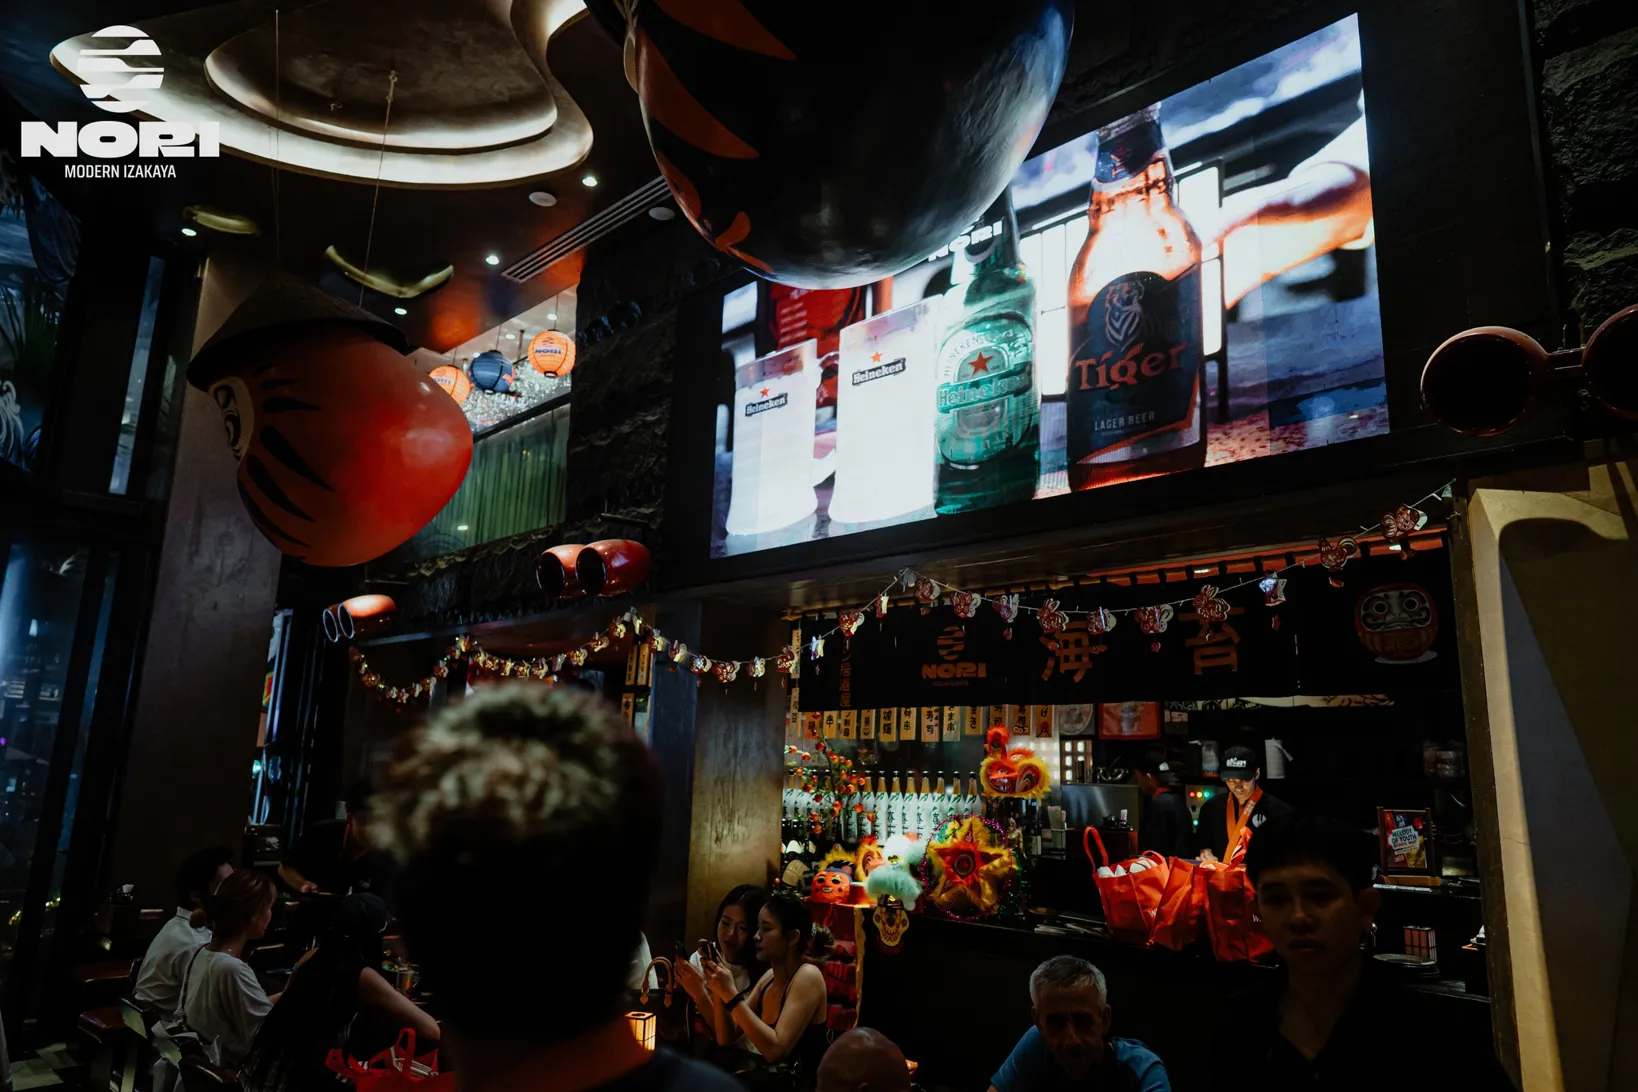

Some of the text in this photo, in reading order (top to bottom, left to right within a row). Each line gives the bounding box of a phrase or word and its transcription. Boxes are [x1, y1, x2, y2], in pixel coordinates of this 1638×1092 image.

[853, 361, 904, 385] Heineken
[1075, 343, 1187, 391] Tiger
[746, 395, 787, 416] Heineken
[1094, 416, 1125, 431] LAGER
[1128, 411, 1155, 425] BEER
[921, 661, 987, 680] NORI
[1400, 834, 1417, 842] YOUTH
